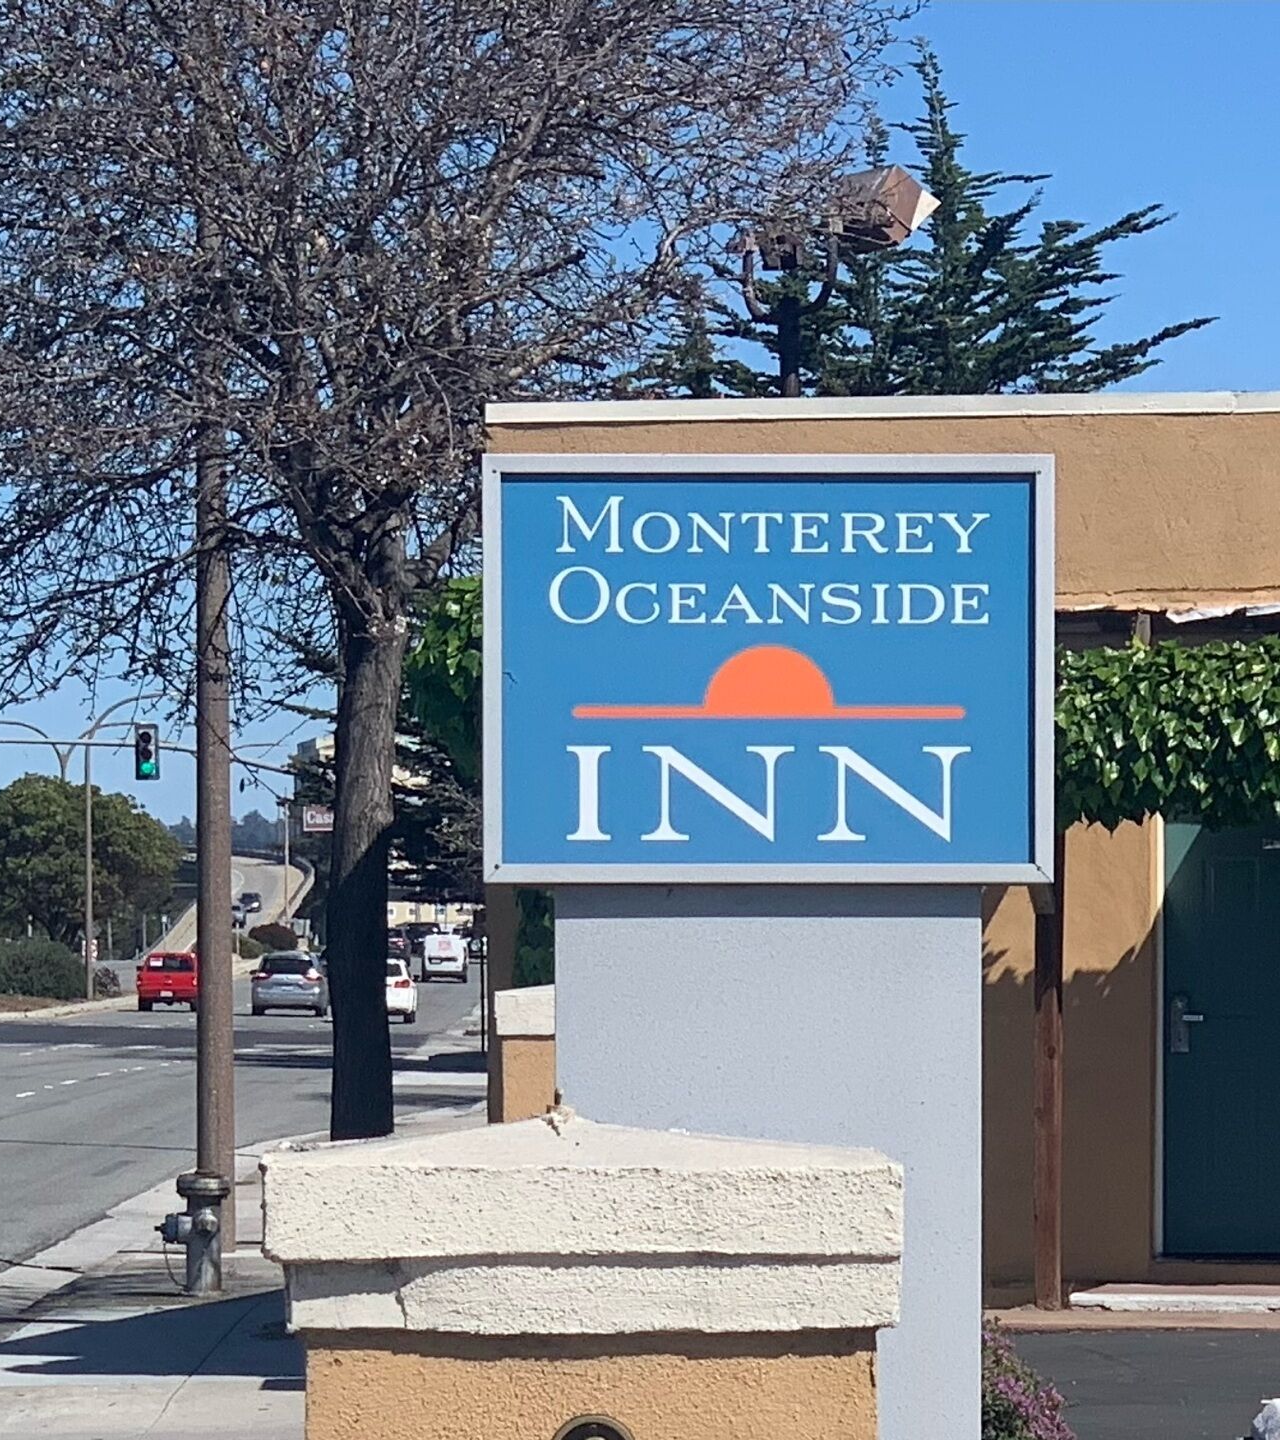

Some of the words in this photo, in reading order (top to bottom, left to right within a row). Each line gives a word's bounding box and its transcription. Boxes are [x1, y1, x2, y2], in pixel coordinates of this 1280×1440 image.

[555, 495, 990, 554] MONTEREY
[549, 566, 989, 625] OCEANSIDE
[566, 745, 971, 843] INN
